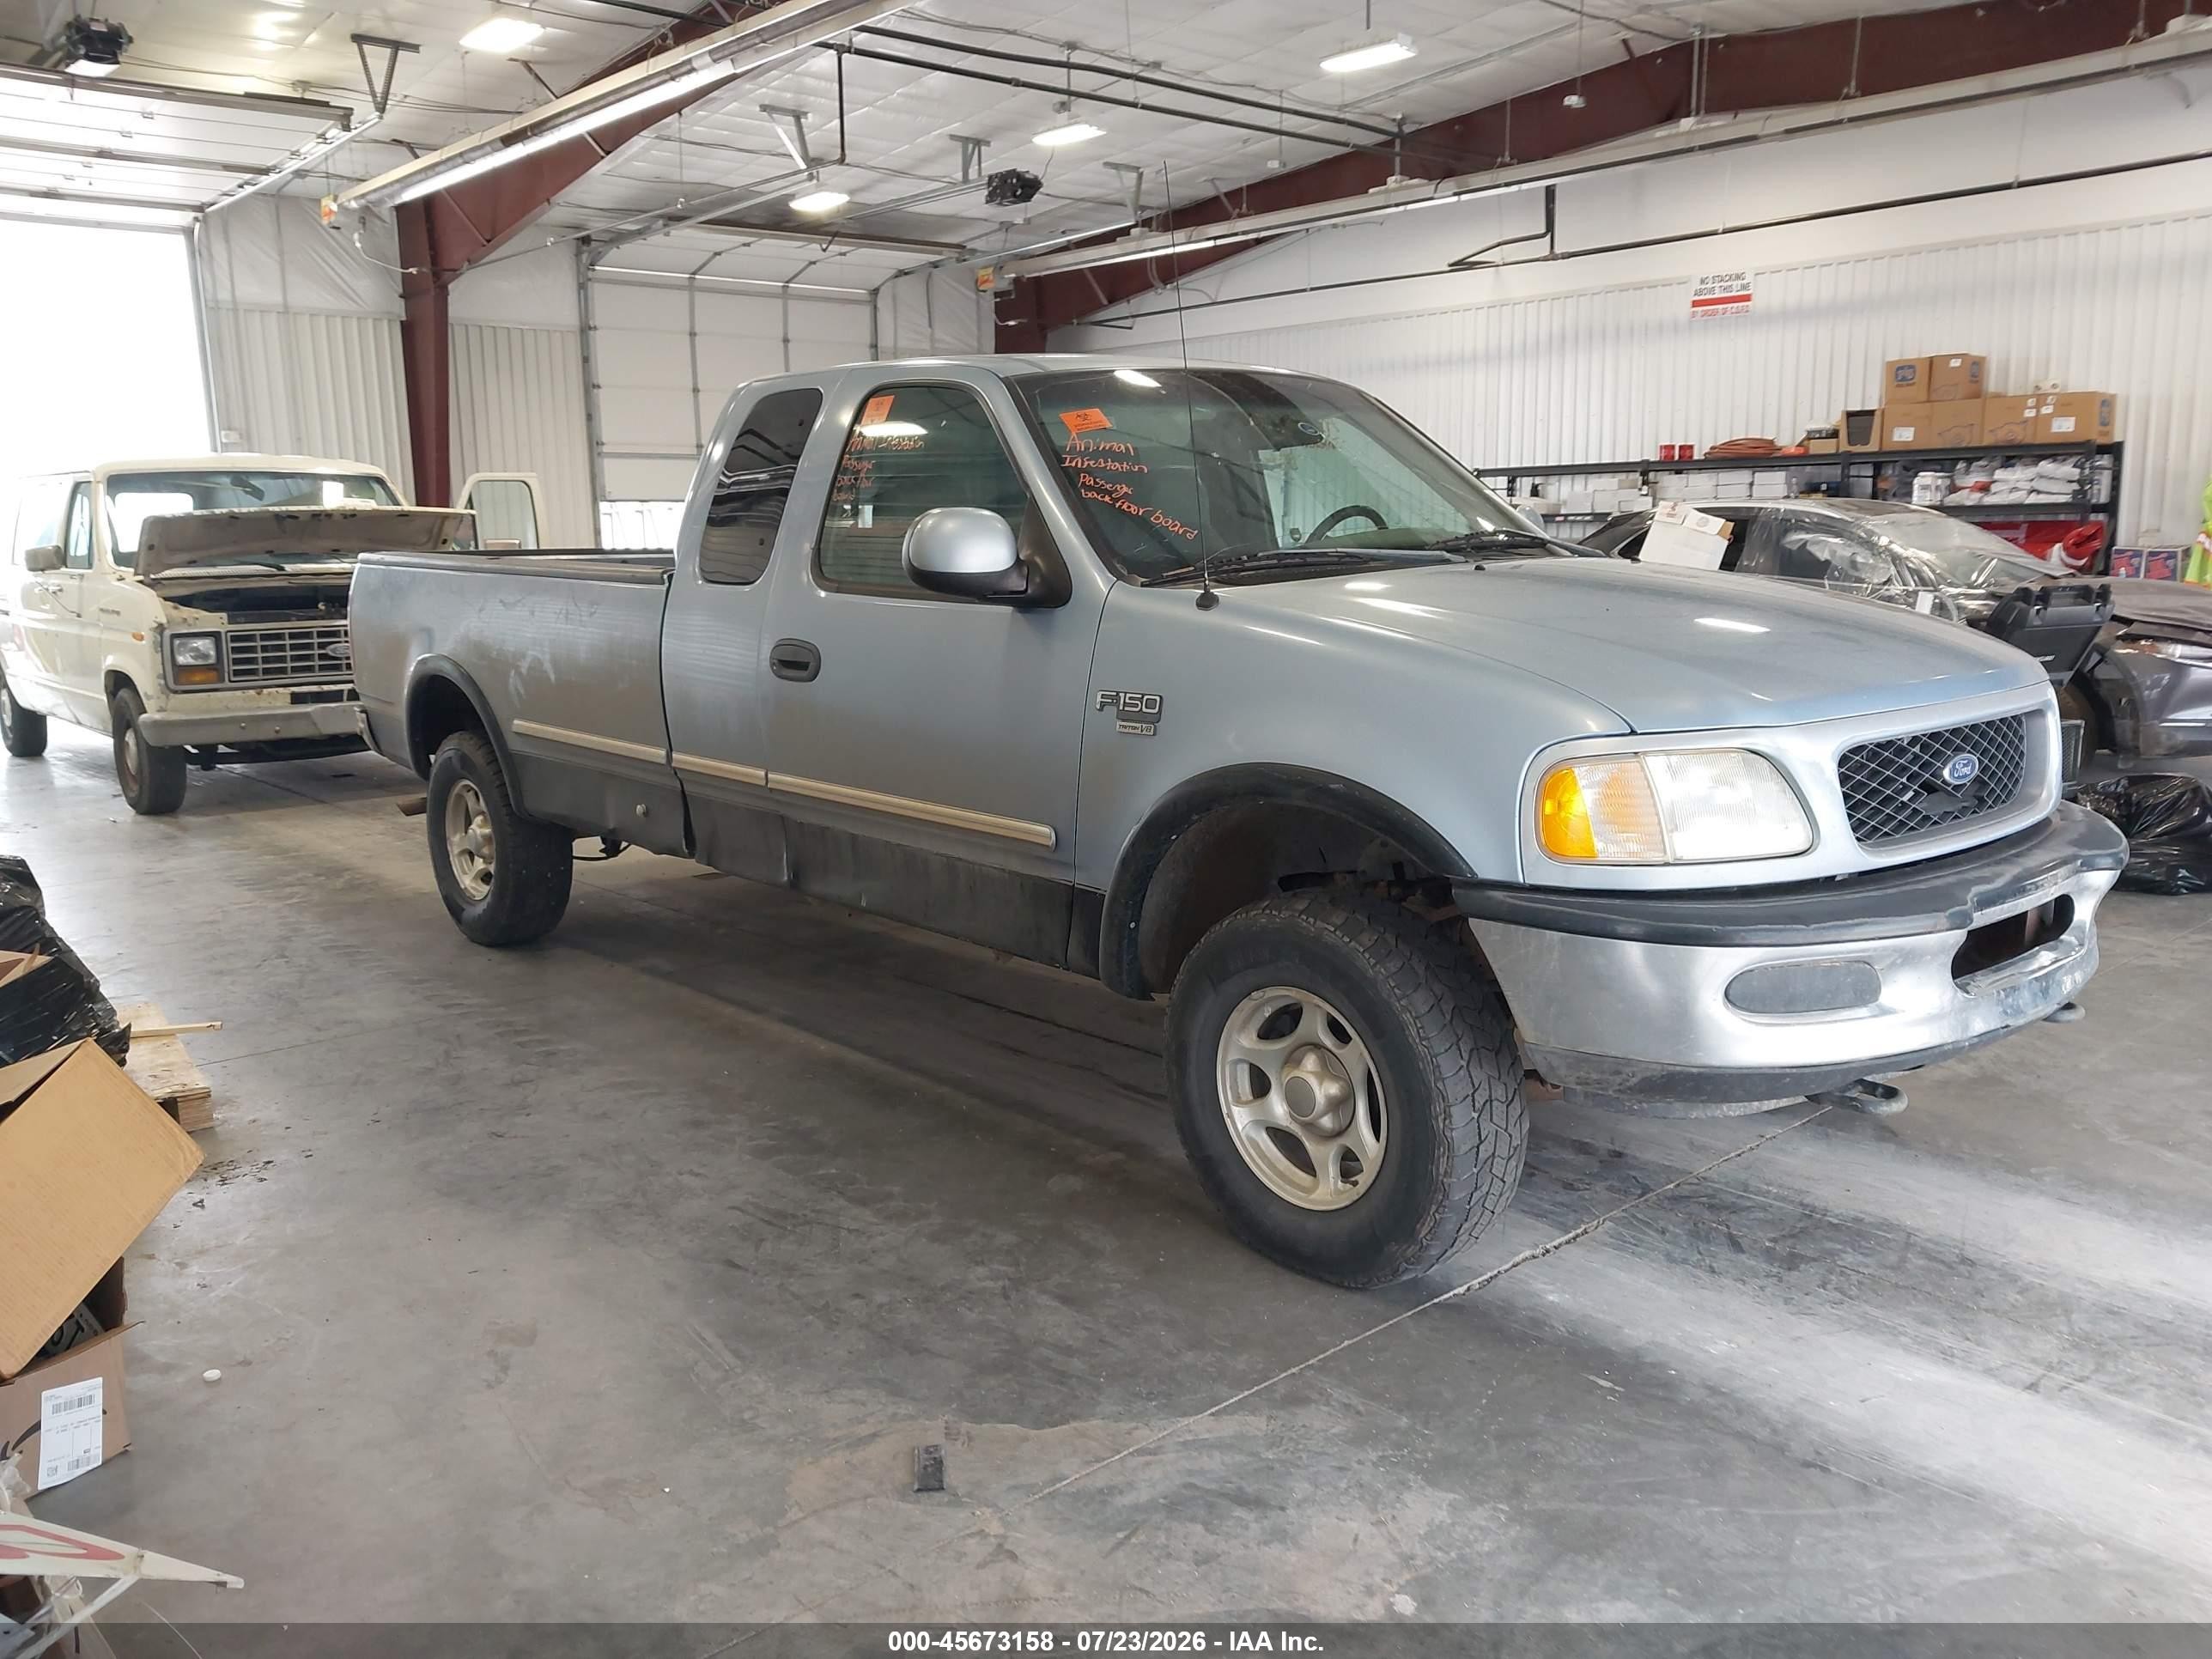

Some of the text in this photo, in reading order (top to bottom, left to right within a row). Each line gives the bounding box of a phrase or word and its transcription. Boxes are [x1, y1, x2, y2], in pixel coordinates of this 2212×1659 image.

[1700, 271, 1747, 285] NO STACKING
[1693, 282, 1752, 296] ABOVE THIS LINE
[1066, 433, 1134, 456] Animal
[1081, 489, 1199, 540] back floor board
[1140, 725, 1152, 733] V8
[1954, 759, 1972, 777] Ford
